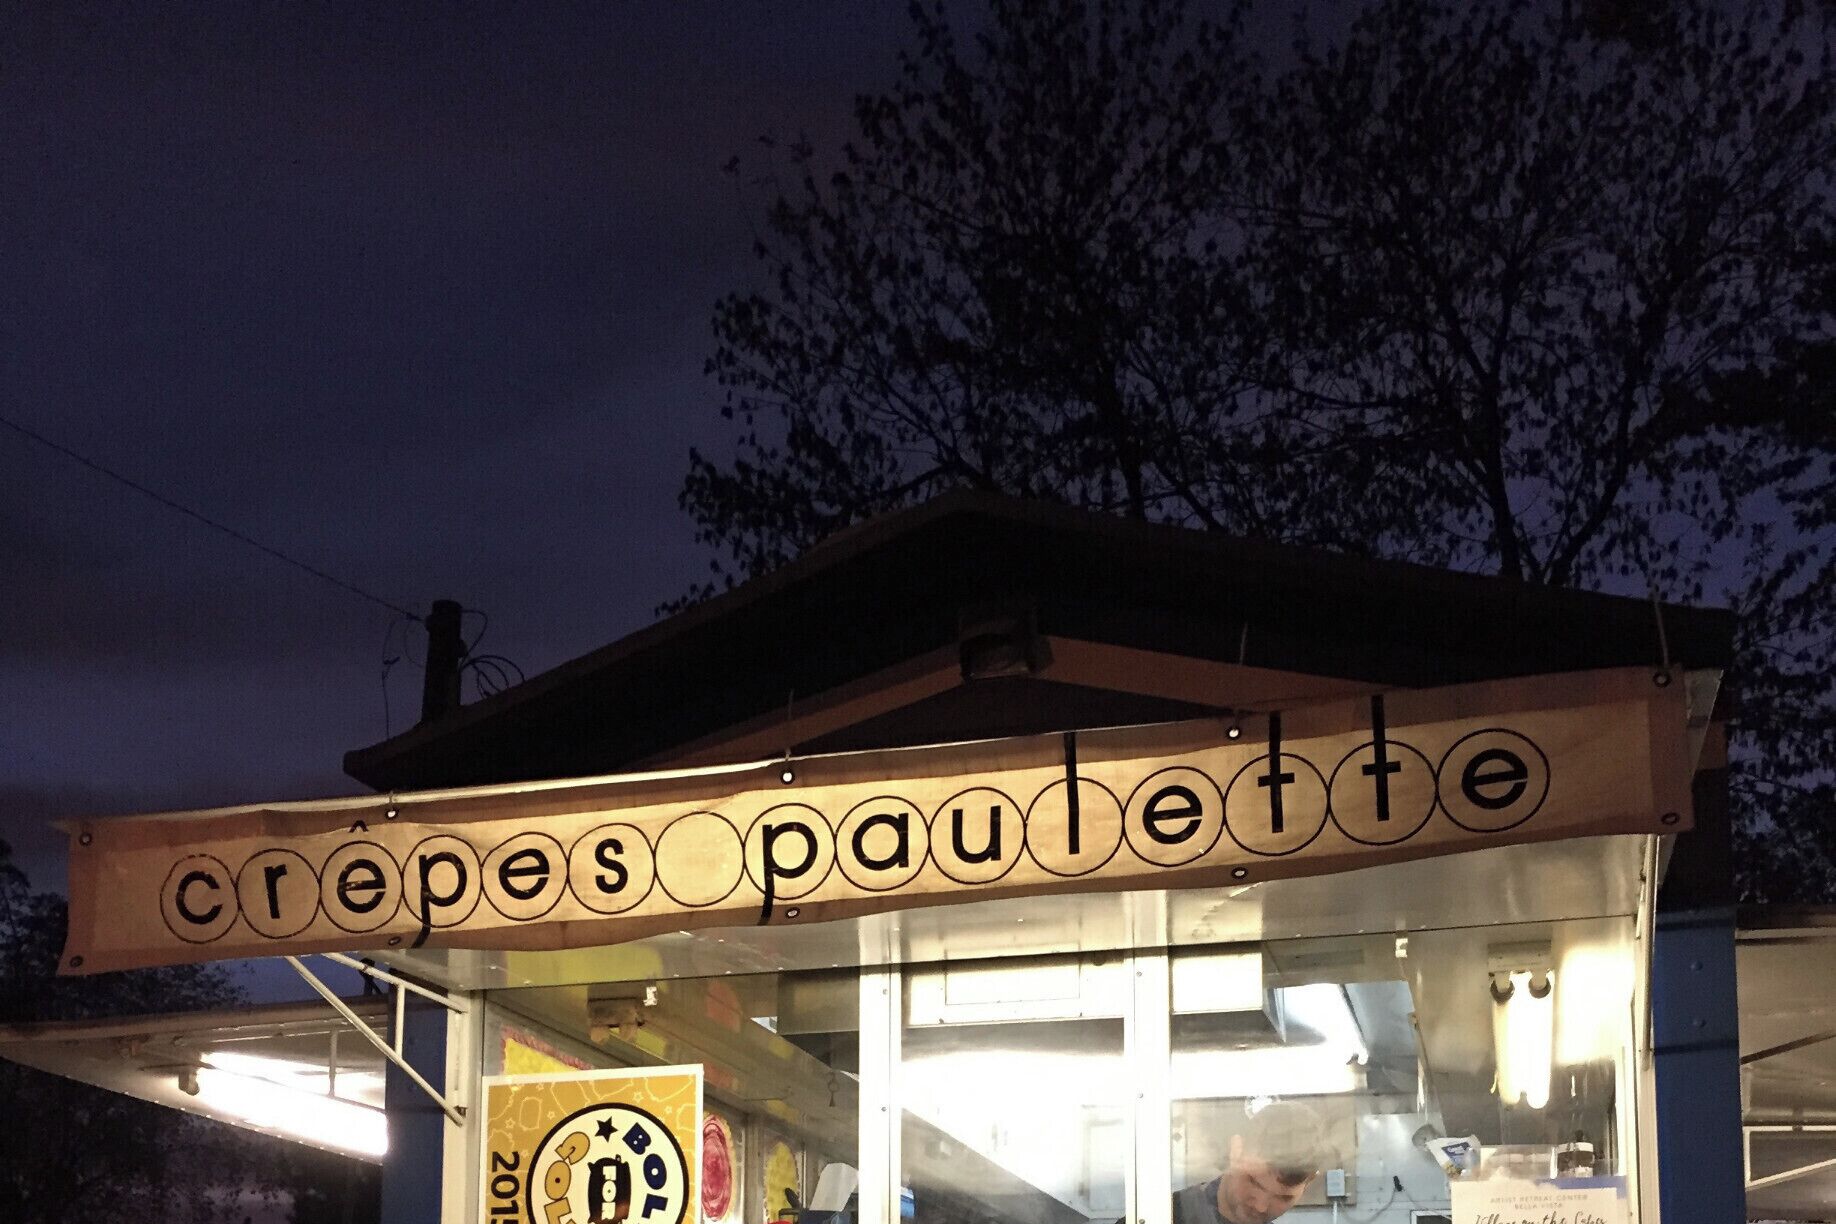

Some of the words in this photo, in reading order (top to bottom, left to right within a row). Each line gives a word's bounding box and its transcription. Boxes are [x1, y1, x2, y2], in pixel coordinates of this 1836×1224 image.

[173, 820, 630, 949] crêpes
[760, 694, 1529, 926] paulette
[600, 1165, 617, 1221] FOR
